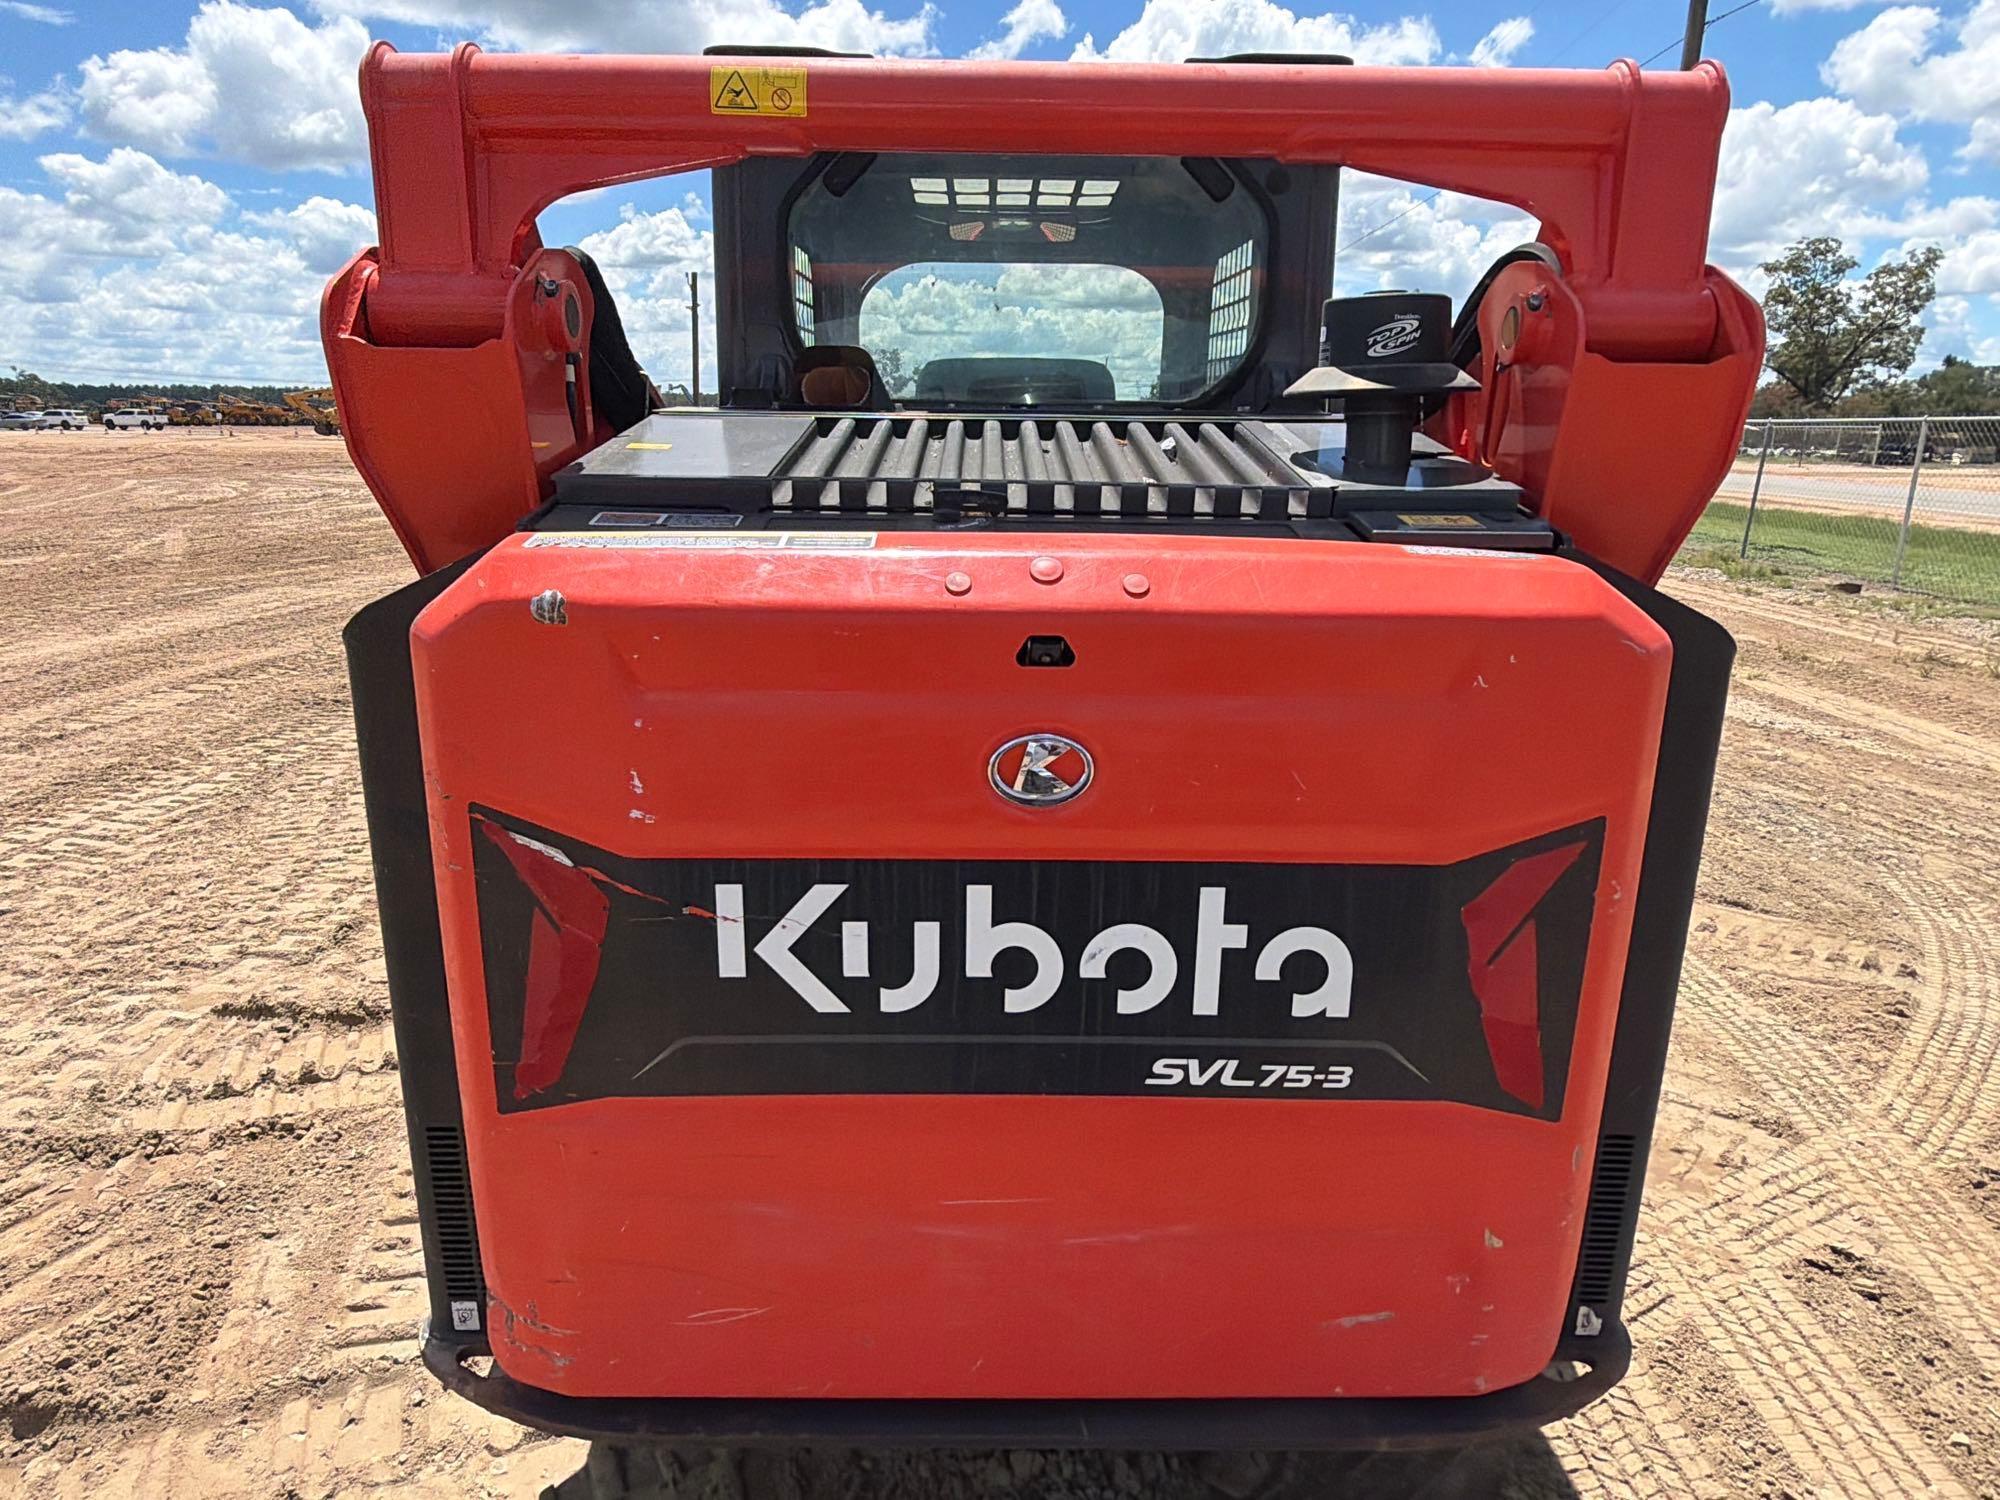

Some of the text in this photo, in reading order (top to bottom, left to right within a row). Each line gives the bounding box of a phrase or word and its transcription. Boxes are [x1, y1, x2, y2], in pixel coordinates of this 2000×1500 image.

[1367, 327, 1402, 345] TOP
[1385, 329, 1421, 349] SPIN
[715, 883, 1354, 1018] Kubota
[1144, 1058, 1354, 1089] SVL 75-3
